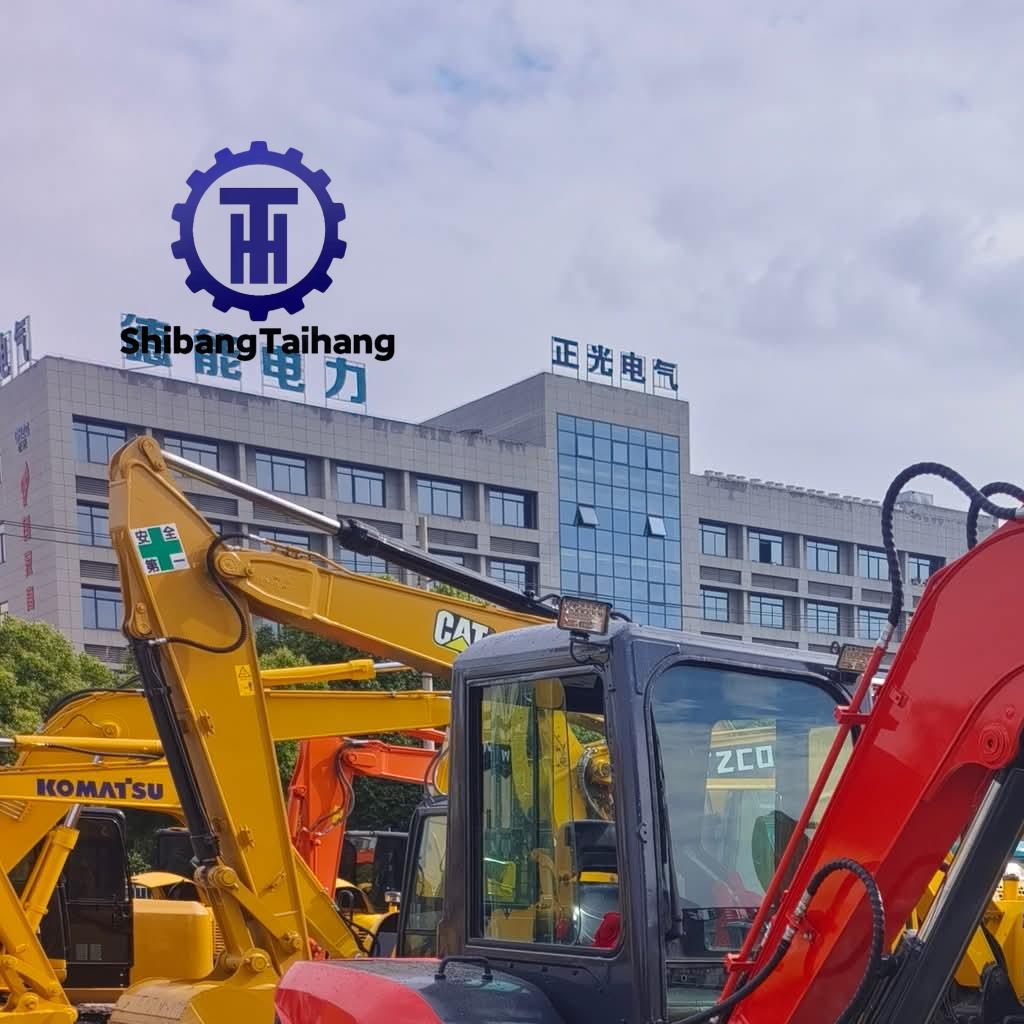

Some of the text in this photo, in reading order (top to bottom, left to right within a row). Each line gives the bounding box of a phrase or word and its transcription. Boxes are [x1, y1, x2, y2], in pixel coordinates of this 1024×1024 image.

[551, 336, 678, 391] 正光电气
[434, 610, 489, 645] CAT
[708, 745, 776, 774] ZCO
[36, 778, 163, 800] KOMATSU
